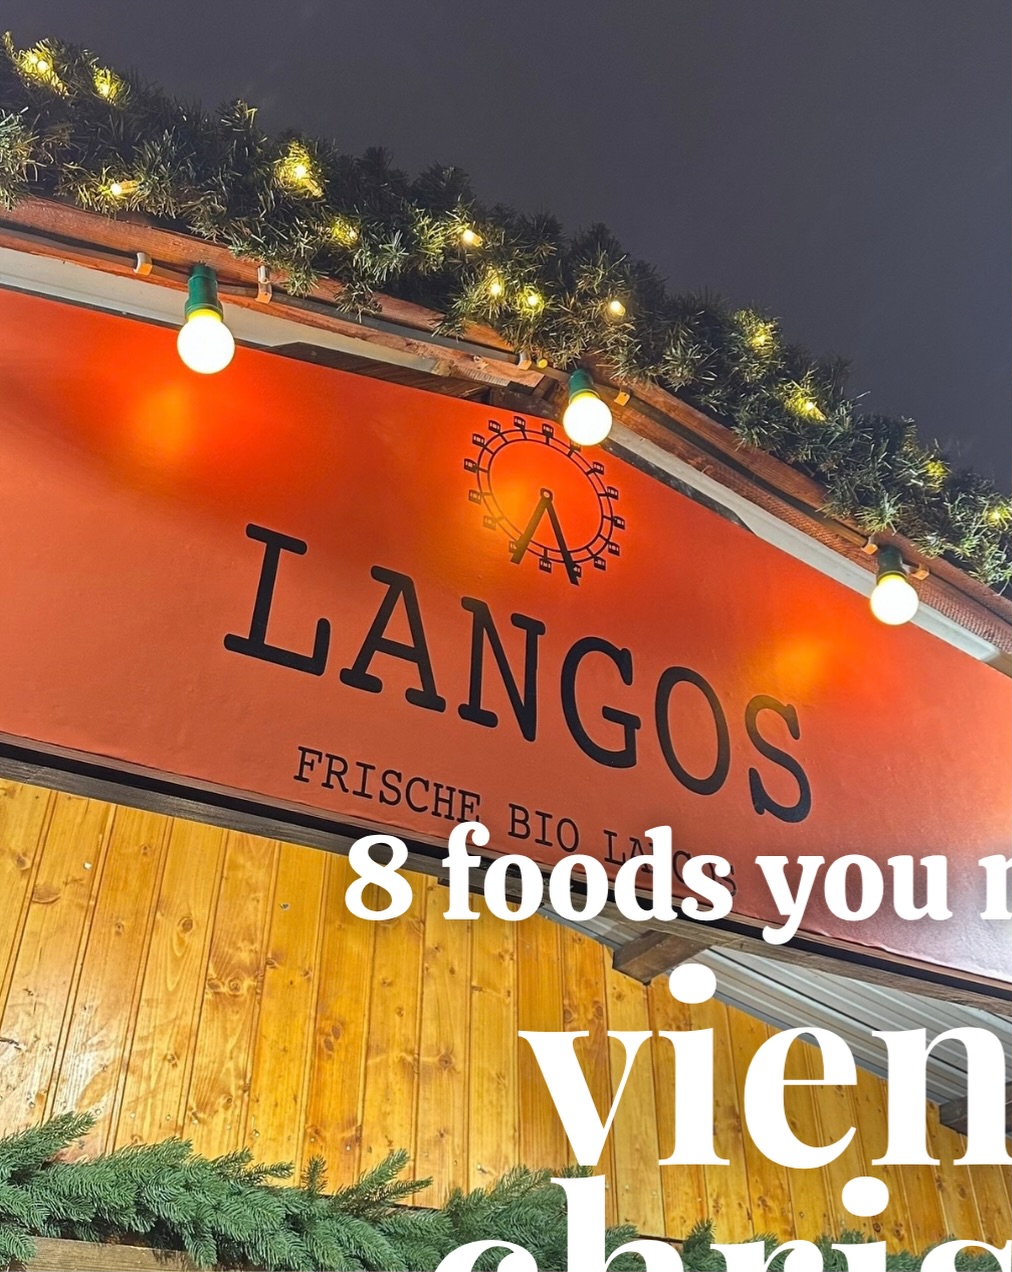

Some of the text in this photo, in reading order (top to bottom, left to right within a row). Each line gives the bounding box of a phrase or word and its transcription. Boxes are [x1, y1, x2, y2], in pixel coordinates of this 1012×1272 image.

[224, 523, 811, 823] LANGOS
[293, 746, 481, 823] FRISCHE
[508, 803, 580, 853] BIO
